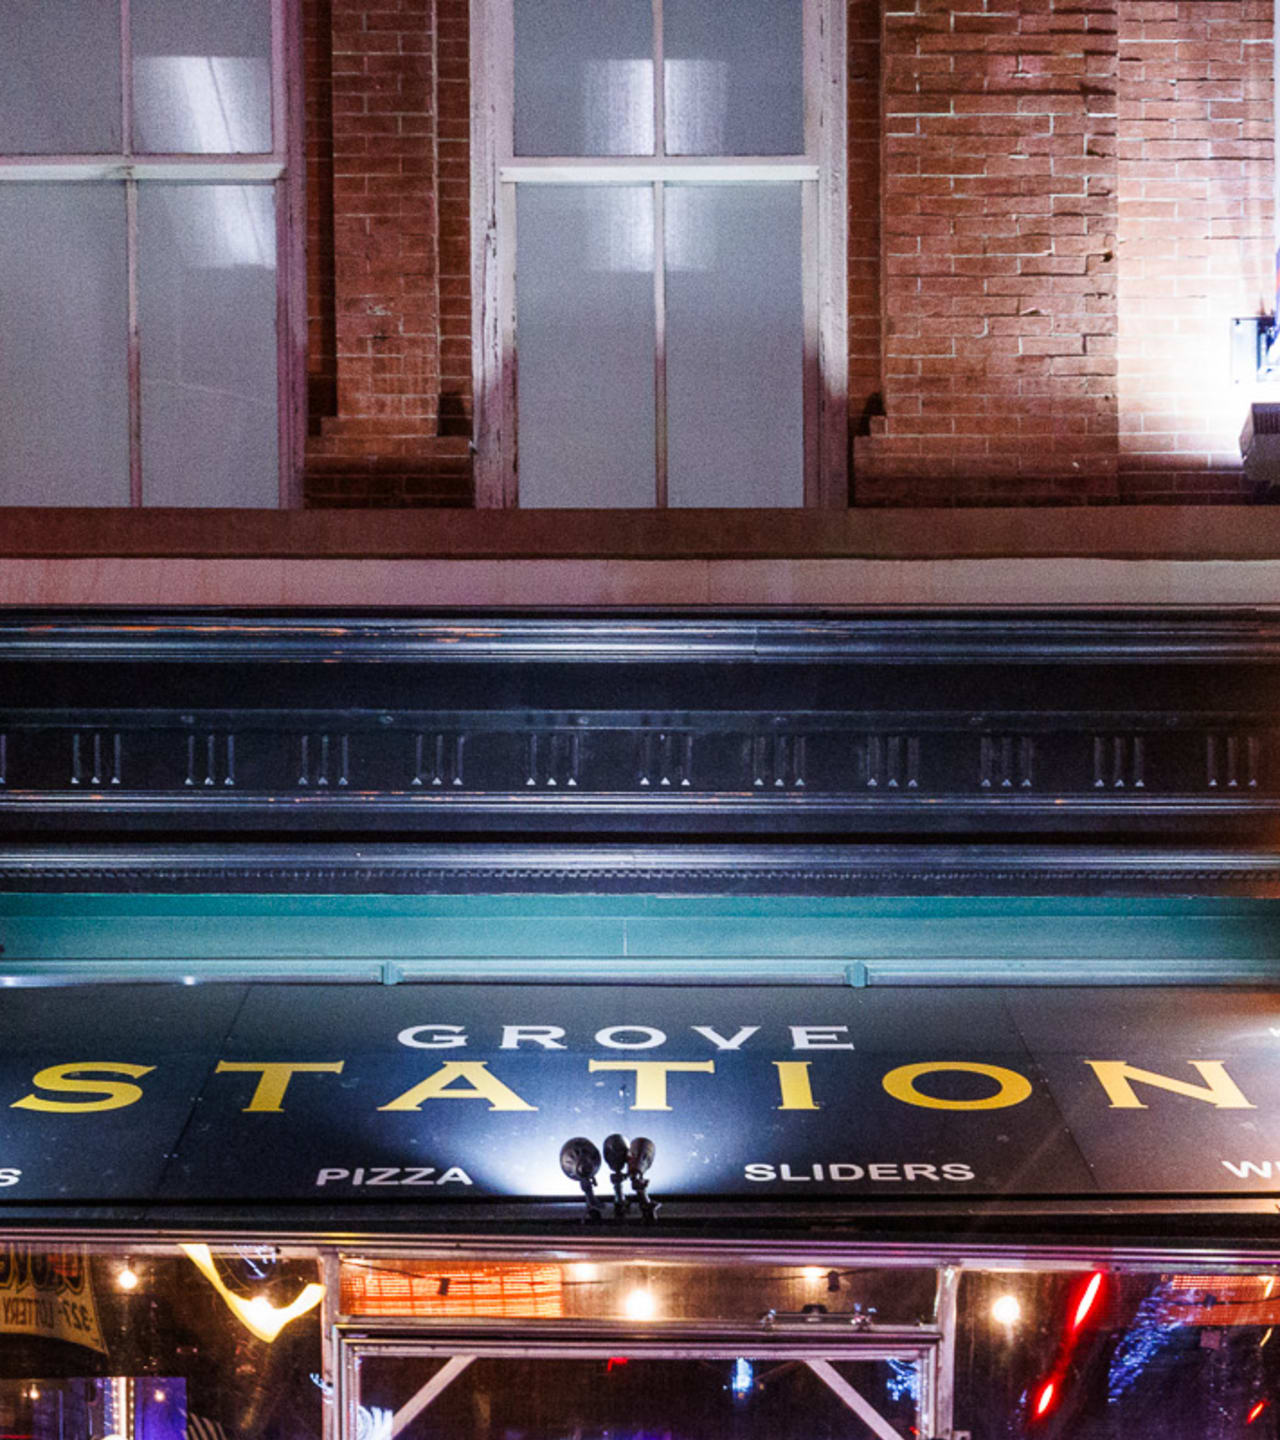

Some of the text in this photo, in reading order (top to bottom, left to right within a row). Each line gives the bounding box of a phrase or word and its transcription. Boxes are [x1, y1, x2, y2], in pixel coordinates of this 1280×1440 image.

[397, 1023, 856, 1050] GROVE
[9, 1059, 1258, 1113] STATION
[315, 1167, 474, 1187] PIZZA
[744, 1162, 977, 1183] SLIDERS
